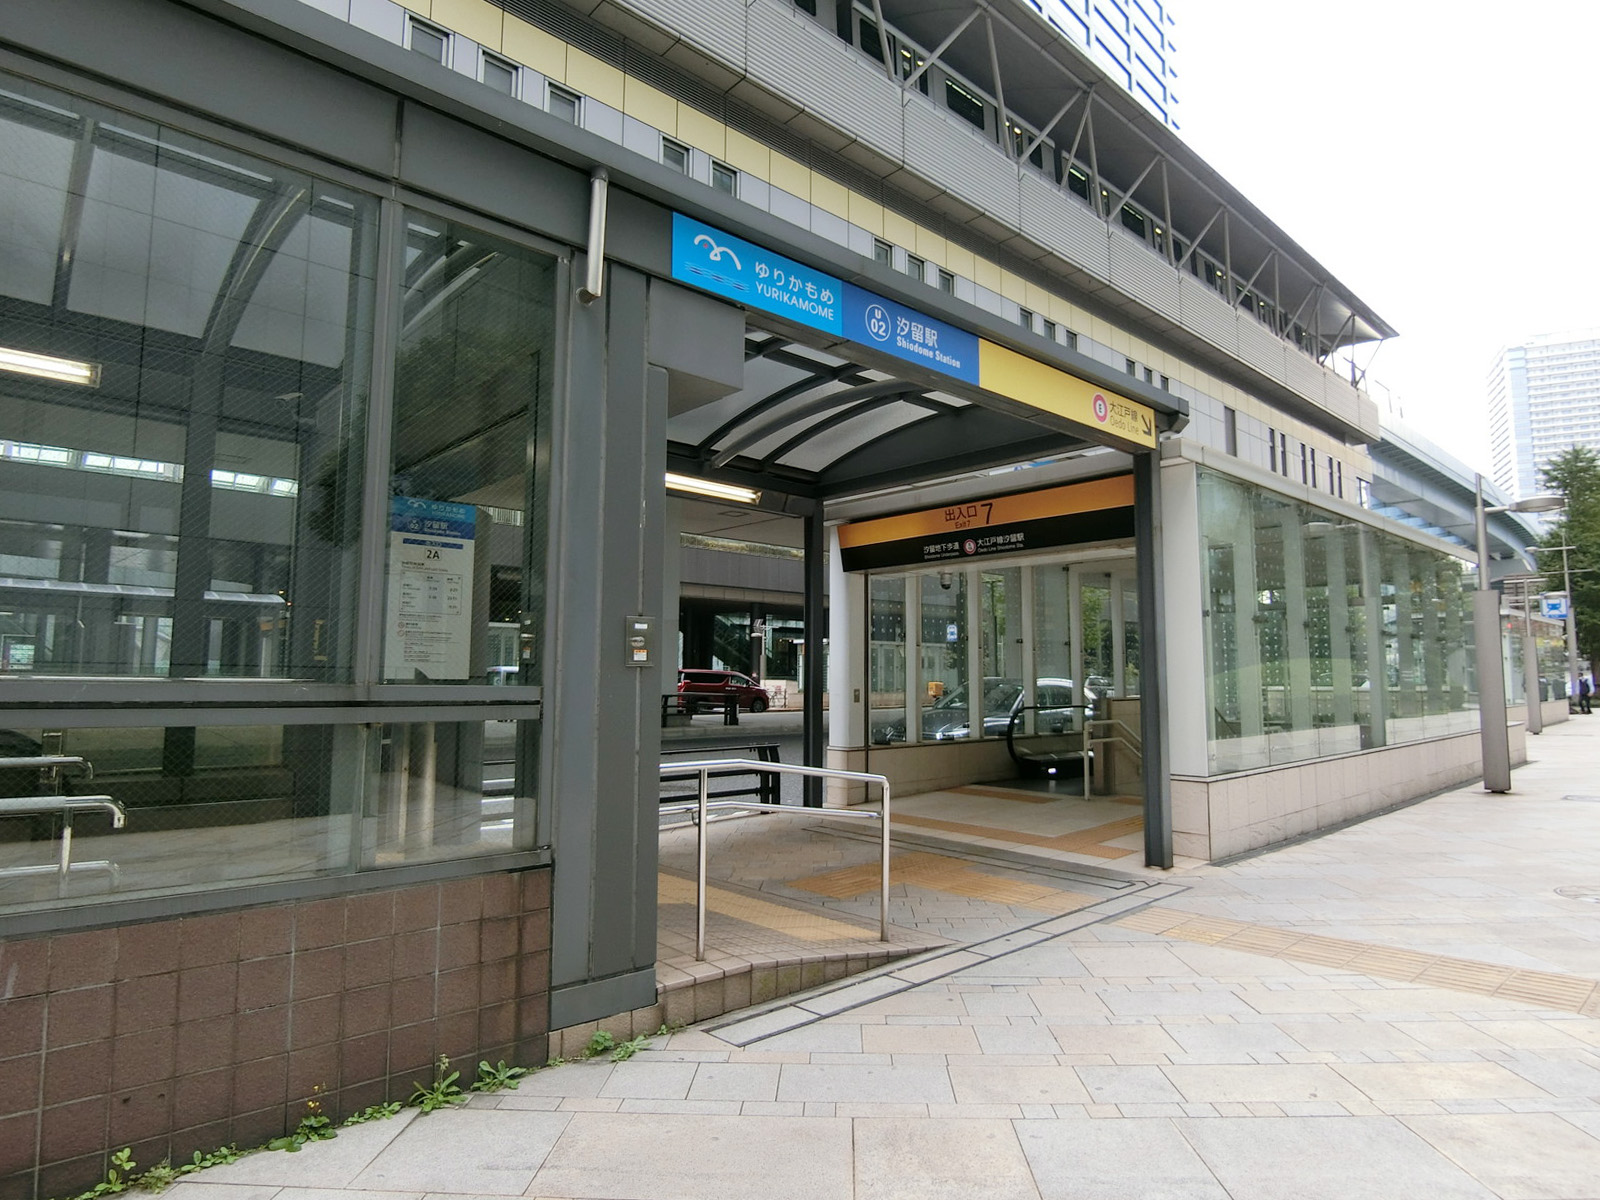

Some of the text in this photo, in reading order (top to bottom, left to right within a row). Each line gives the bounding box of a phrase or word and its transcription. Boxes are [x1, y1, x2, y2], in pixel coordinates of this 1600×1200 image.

[755, 261, 834, 305] ゆりかもめ
[755, 281, 834, 321] YURIKAMOME
[873, 309, 881, 319] U
[870, 318, 887, 337] 02
[896, 316, 938, 348] 汐留駅
[896, 336, 961, 368] Shiodome Station
[1109, 401, 1138, 422] 大江戸線
[944, 502, 993, 524] 出入口 7
[426, 549, 440, 559] 2A
